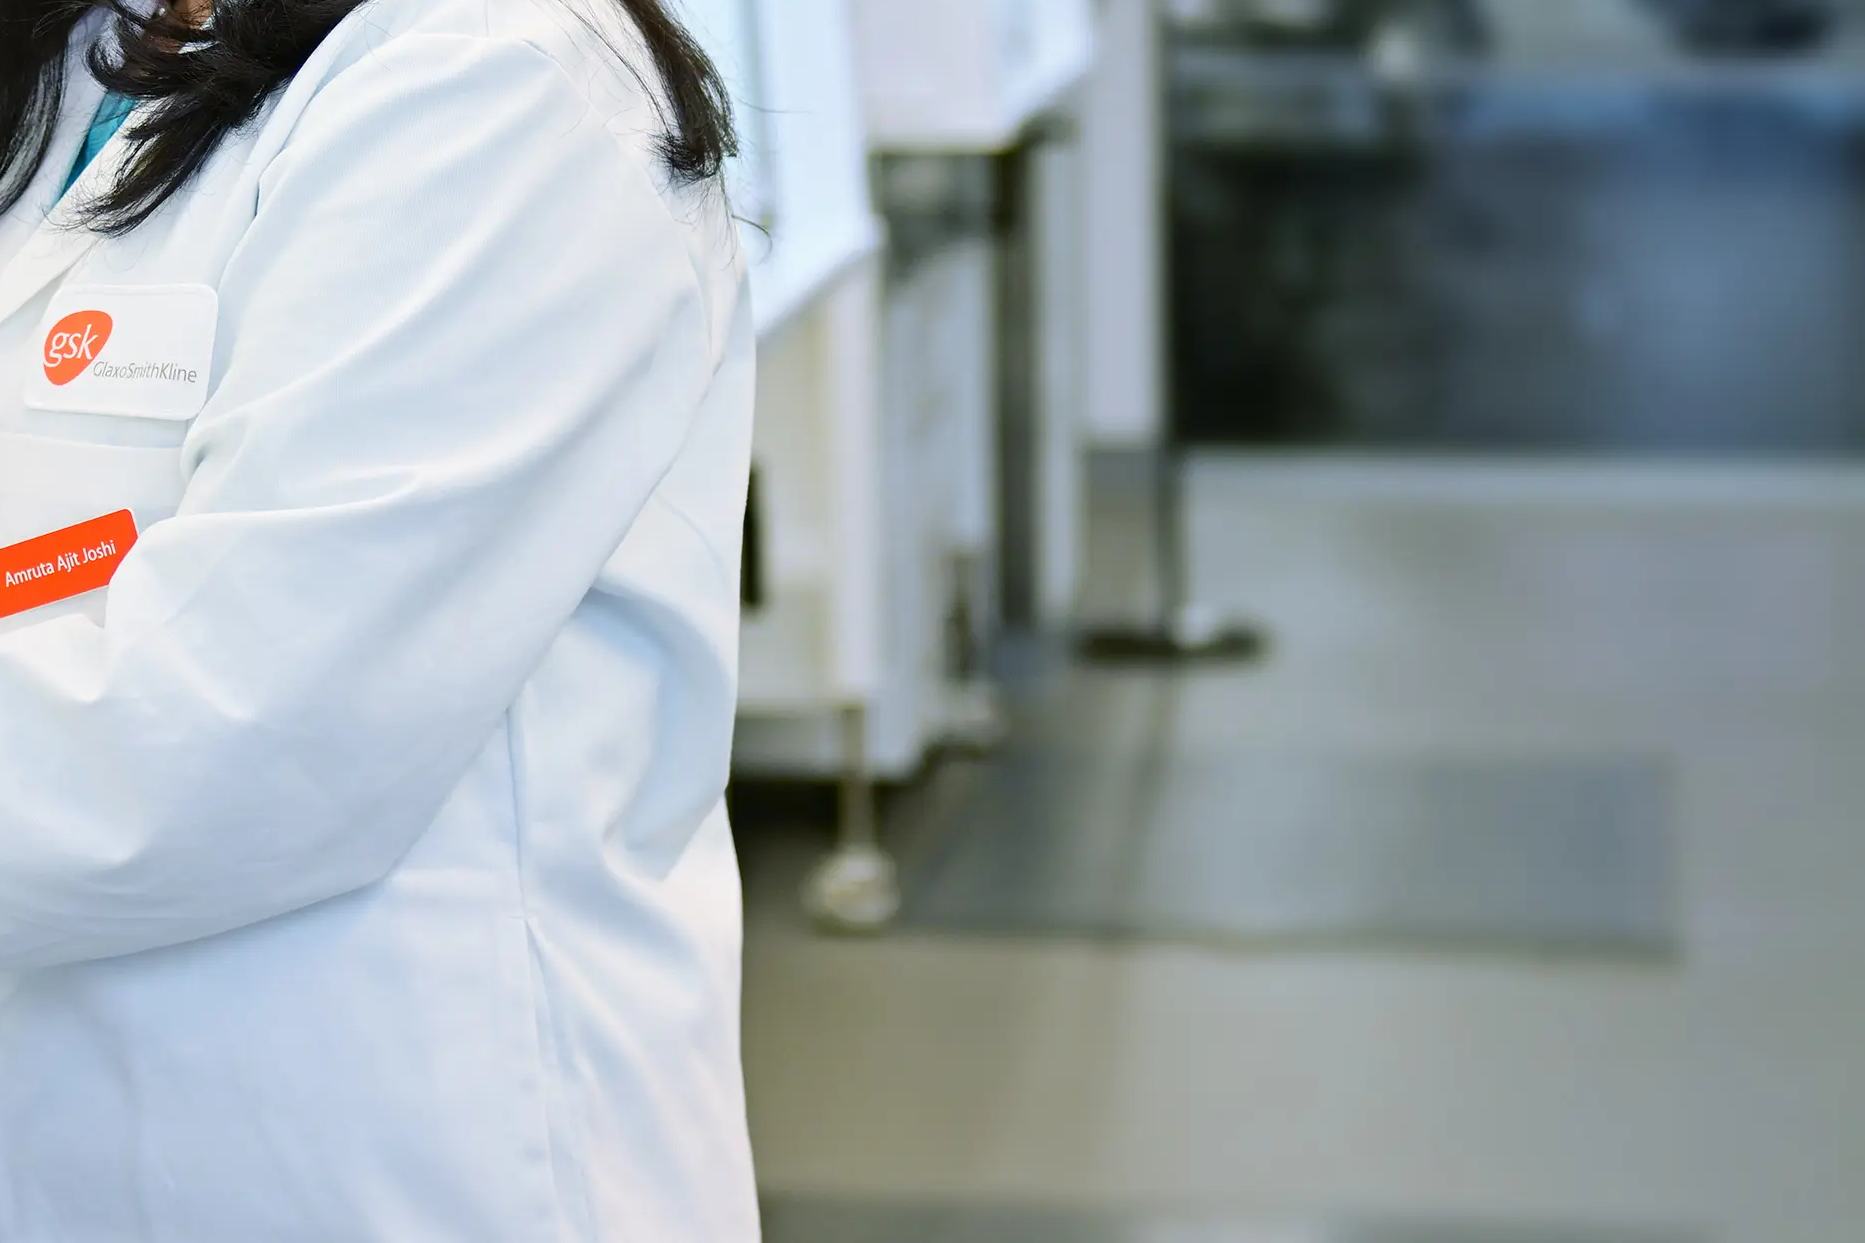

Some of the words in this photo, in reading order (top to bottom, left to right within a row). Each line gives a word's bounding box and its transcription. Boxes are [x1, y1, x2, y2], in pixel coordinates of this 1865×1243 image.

[43, 323, 99, 368] gsk
[92, 360, 198, 384] GlaxoSmithKline
[5, 561, 55, 588] Amruta
[57, 551, 81, 573] Ajit
[82, 539, 117, 564] Joshi
